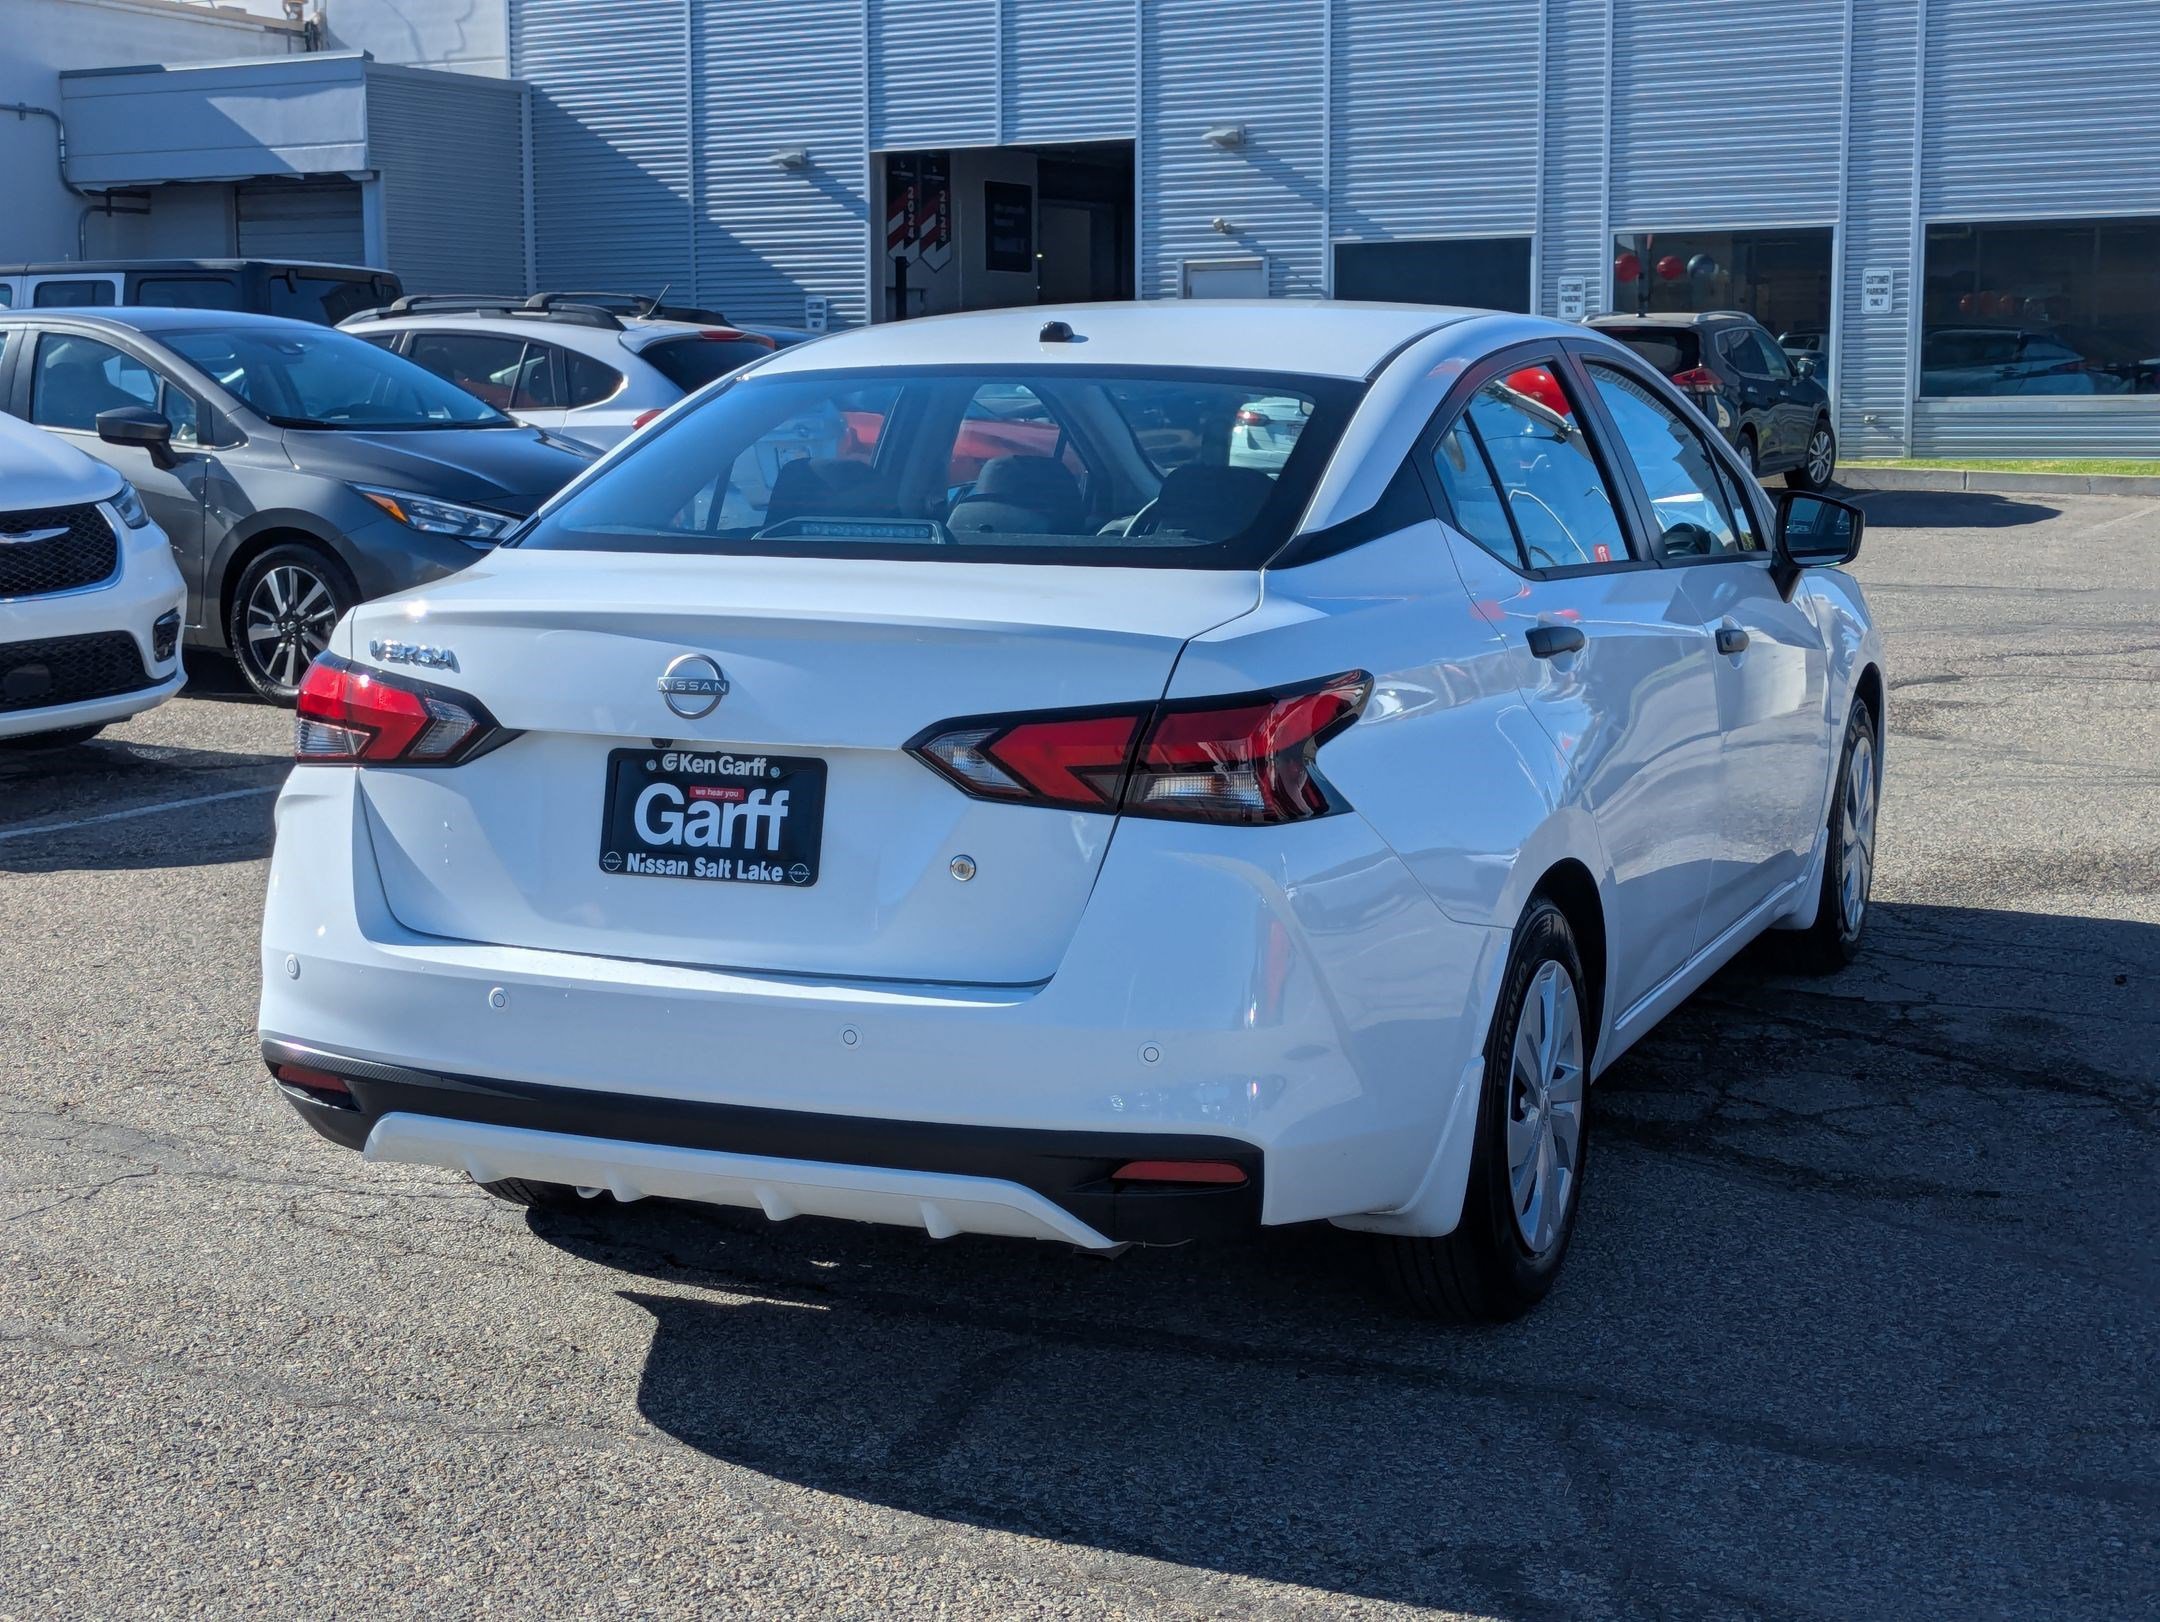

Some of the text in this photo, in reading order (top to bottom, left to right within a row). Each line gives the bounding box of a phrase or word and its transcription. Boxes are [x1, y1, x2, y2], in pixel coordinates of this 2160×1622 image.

[369, 638, 461, 674] VERSA
[659, 680, 727, 693] NISSAN
[679, 755, 767, 777] Ken Garff
[708, 788, 722, 797] hear
[634, 782, 790, 851] Garff
[626, 852, 784, 882] Nissan Salt Lake
